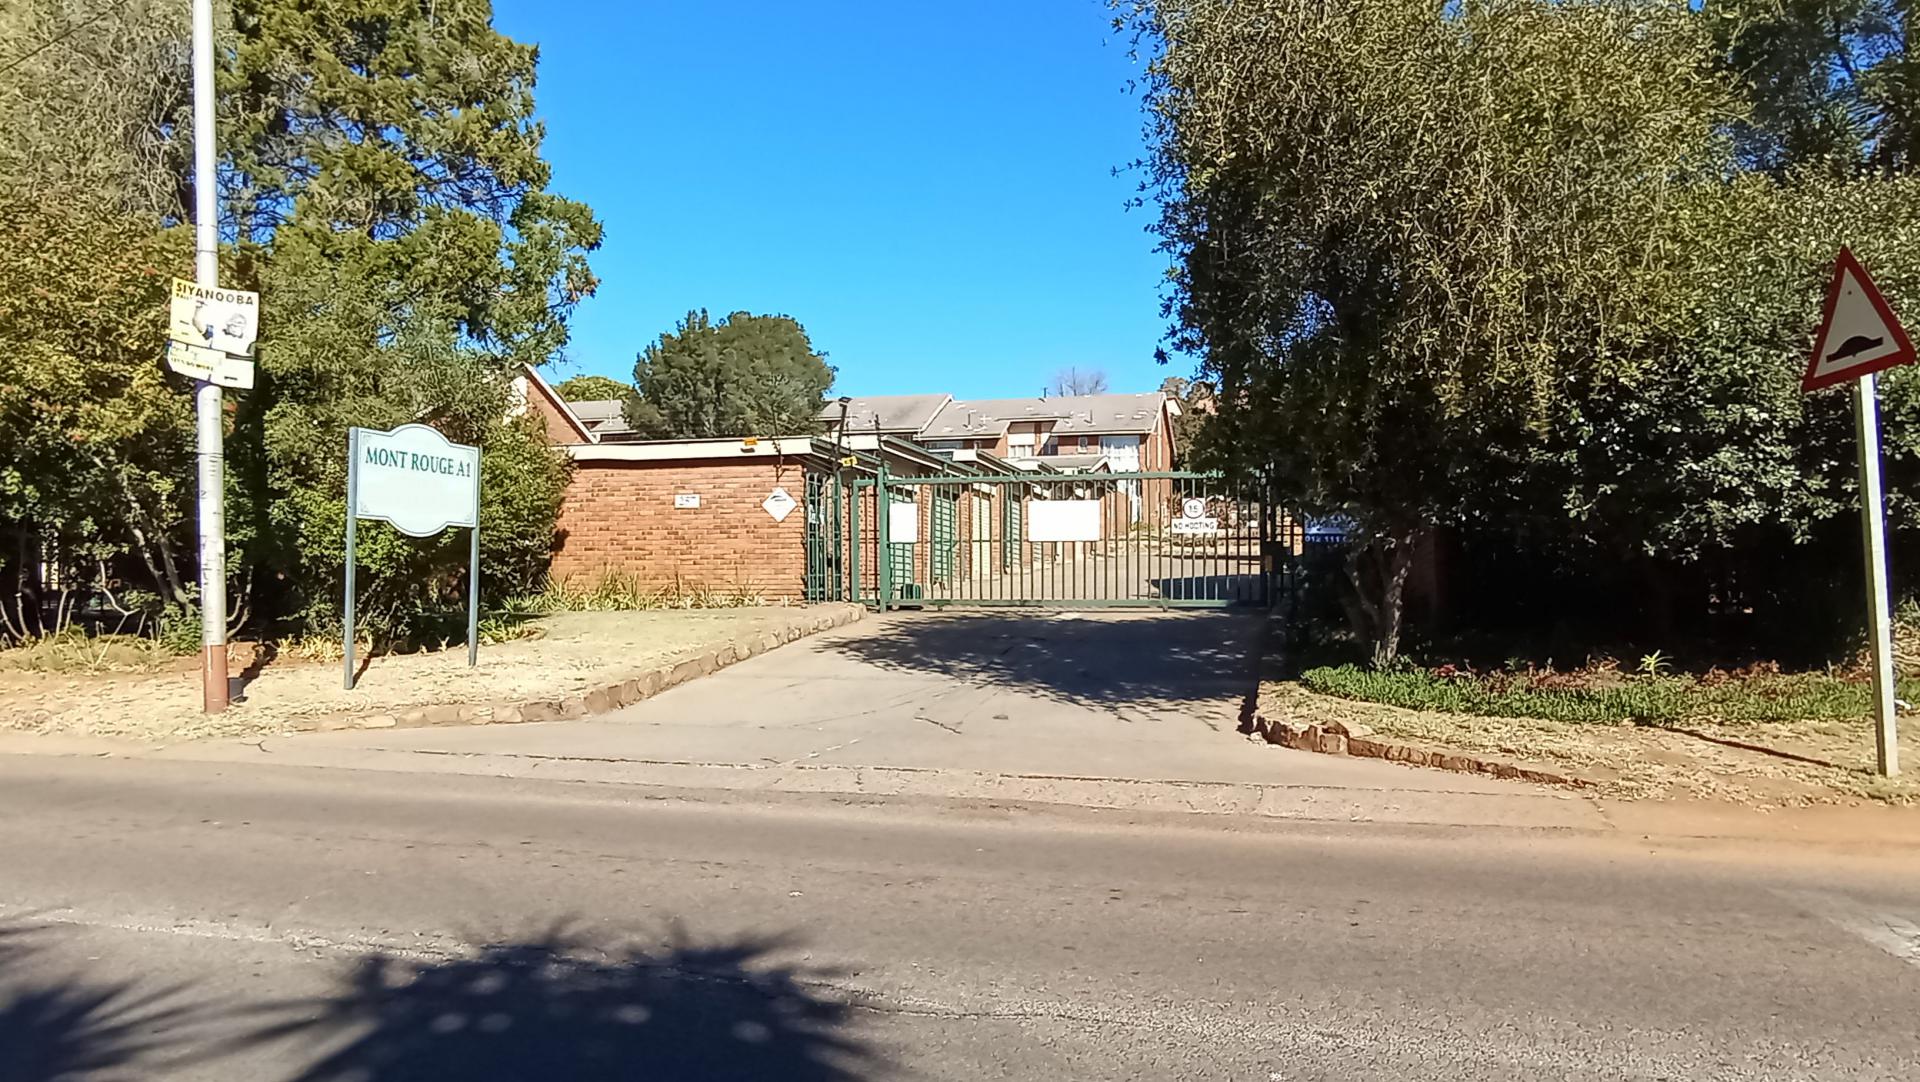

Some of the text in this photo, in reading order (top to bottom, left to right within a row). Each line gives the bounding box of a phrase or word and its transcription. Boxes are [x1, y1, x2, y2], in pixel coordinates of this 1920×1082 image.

[365, 446, 471, 478] MONT ROUGE A1
[1173, 521, 1215, 530] NO HOOTING
